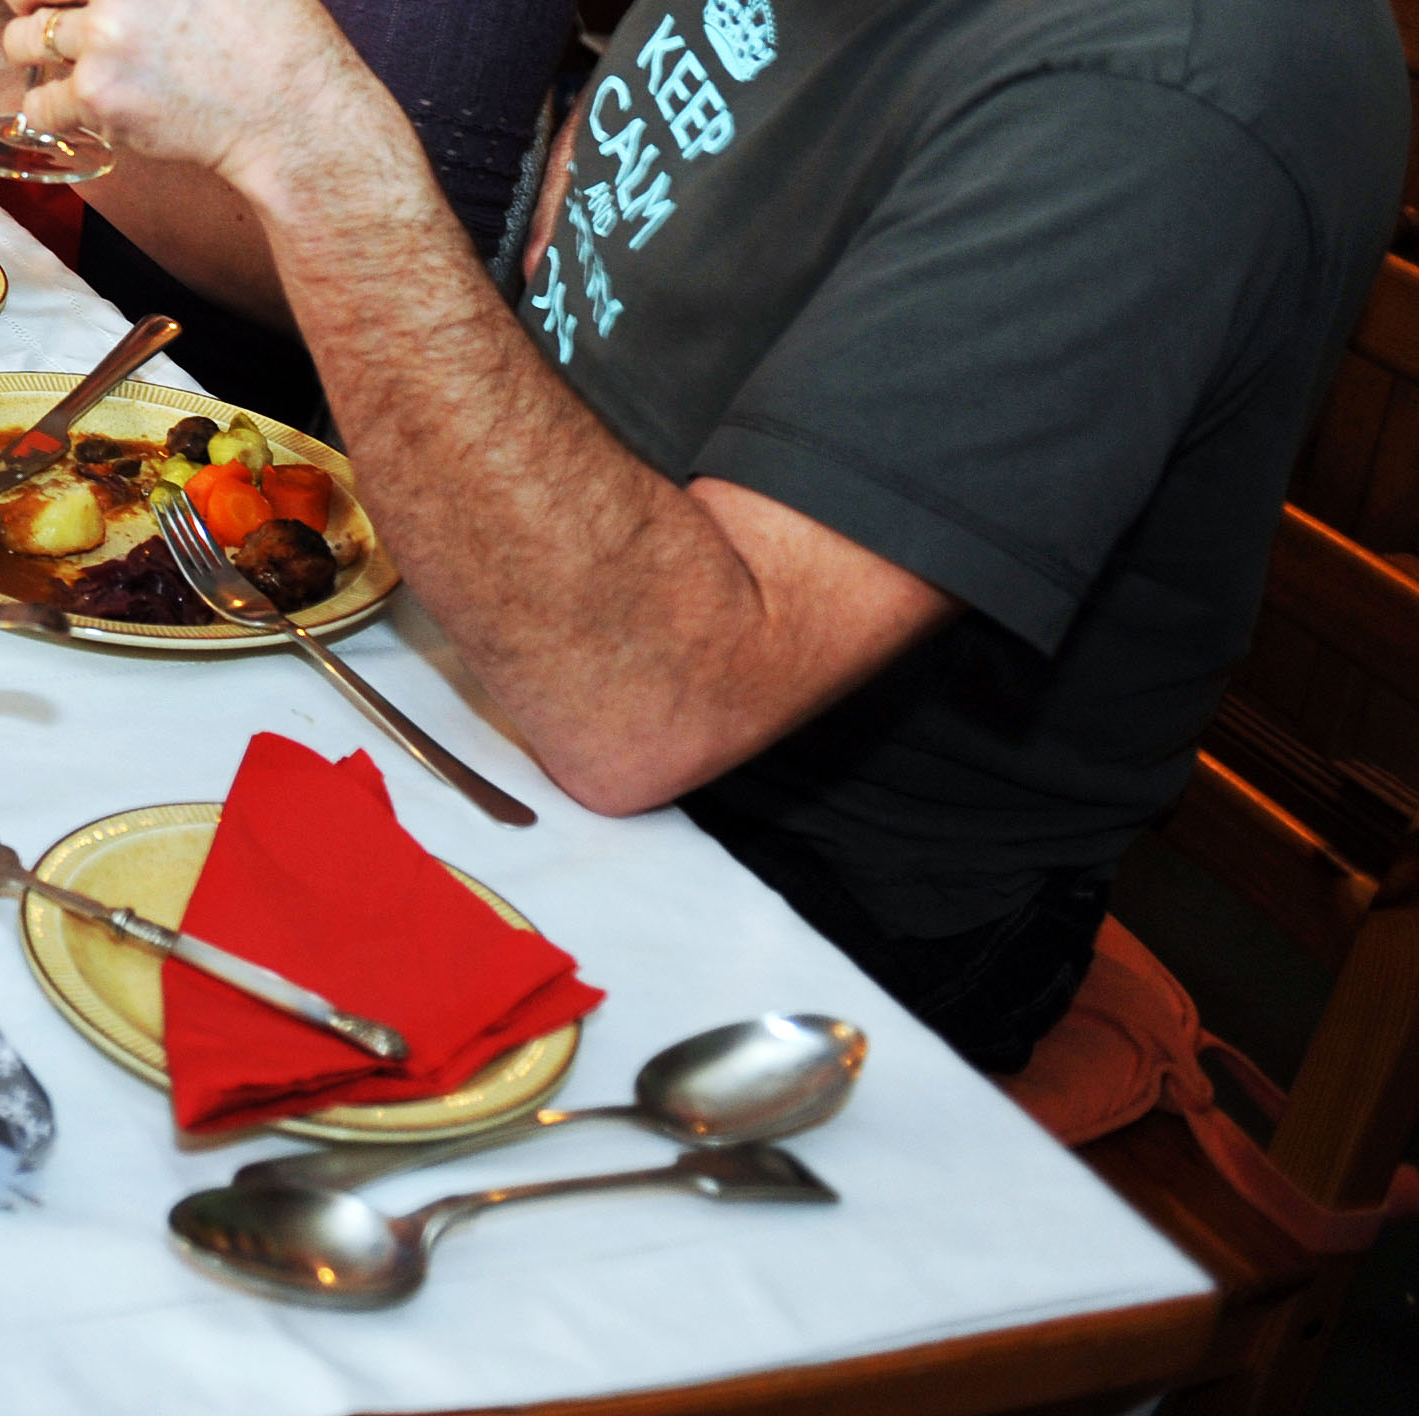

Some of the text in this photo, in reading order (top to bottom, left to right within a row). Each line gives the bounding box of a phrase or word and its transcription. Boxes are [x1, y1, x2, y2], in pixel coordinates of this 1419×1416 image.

[636, 13, 736, 161] KEEP
[583, 181, 620, 238] AND
[589, 74, 679, 251] CALM
